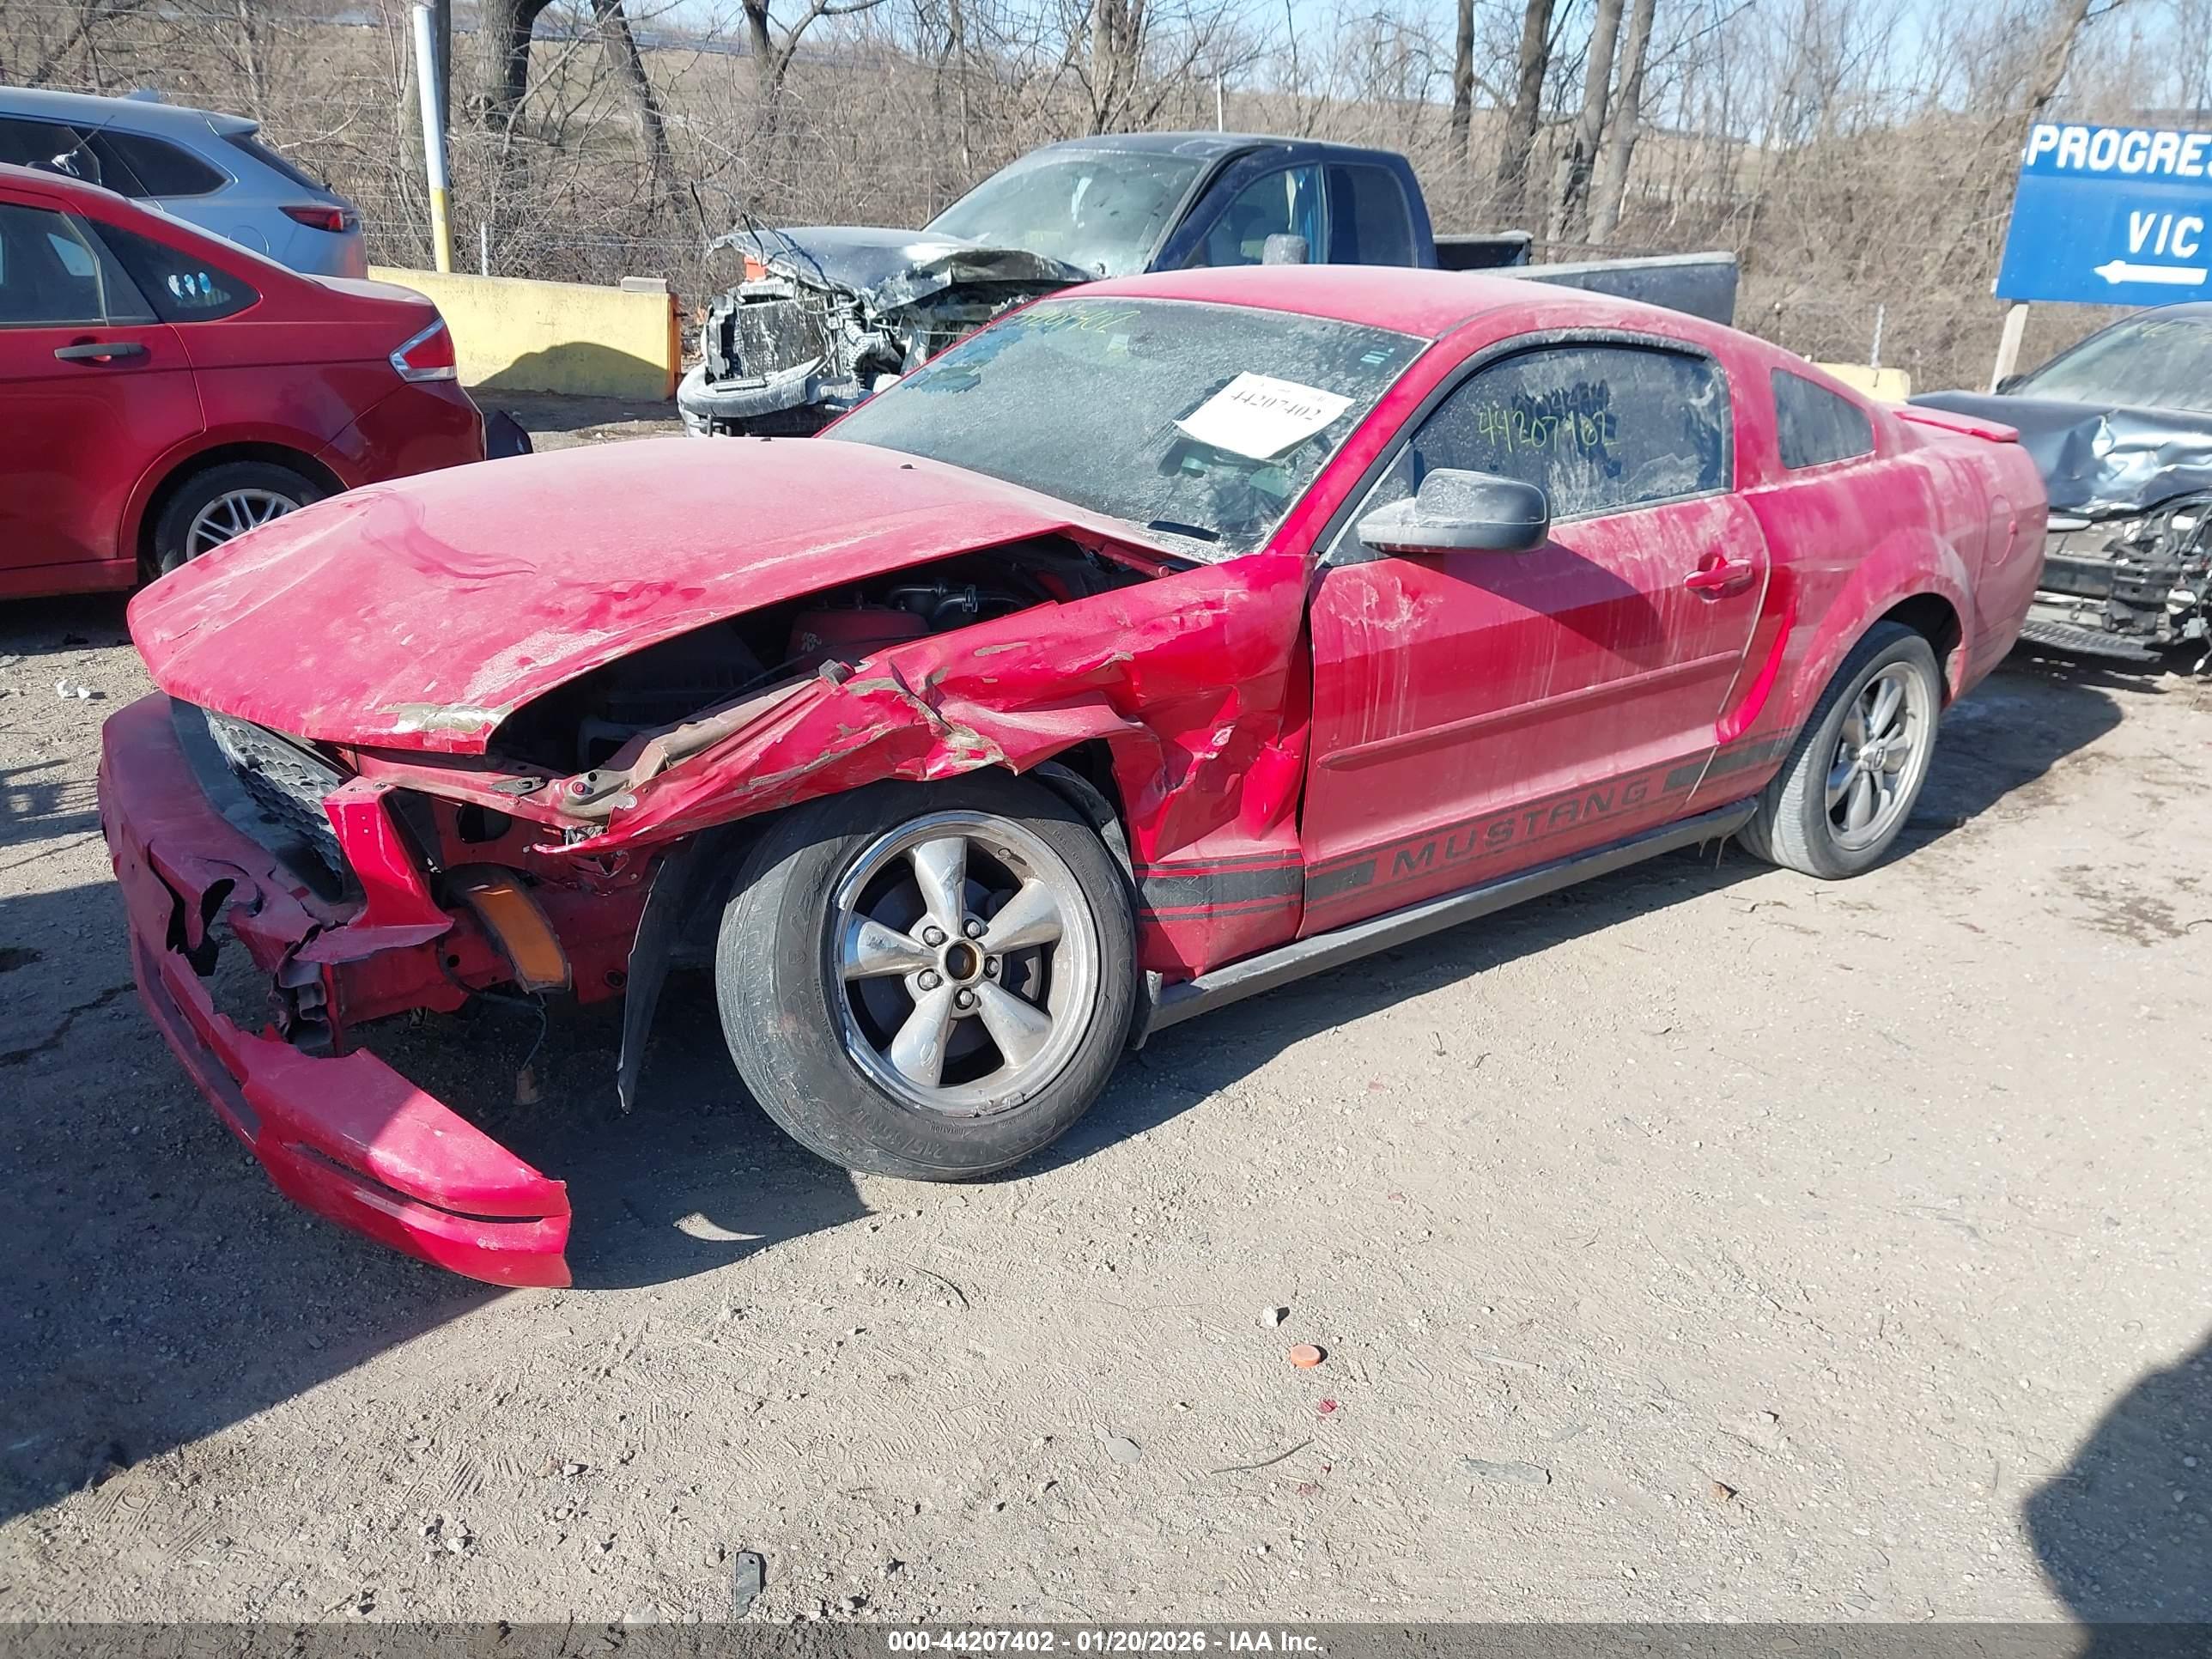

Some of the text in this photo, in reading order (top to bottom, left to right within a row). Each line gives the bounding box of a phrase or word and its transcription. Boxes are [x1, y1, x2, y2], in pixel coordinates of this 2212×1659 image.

[2025, 124, 2212, 178] PROGRE
[2129, 211, 2204, 258] VIC
[1230, 390, 1322, 421] 44207402
[1391, 776, 1650, 878] MUSTANG
